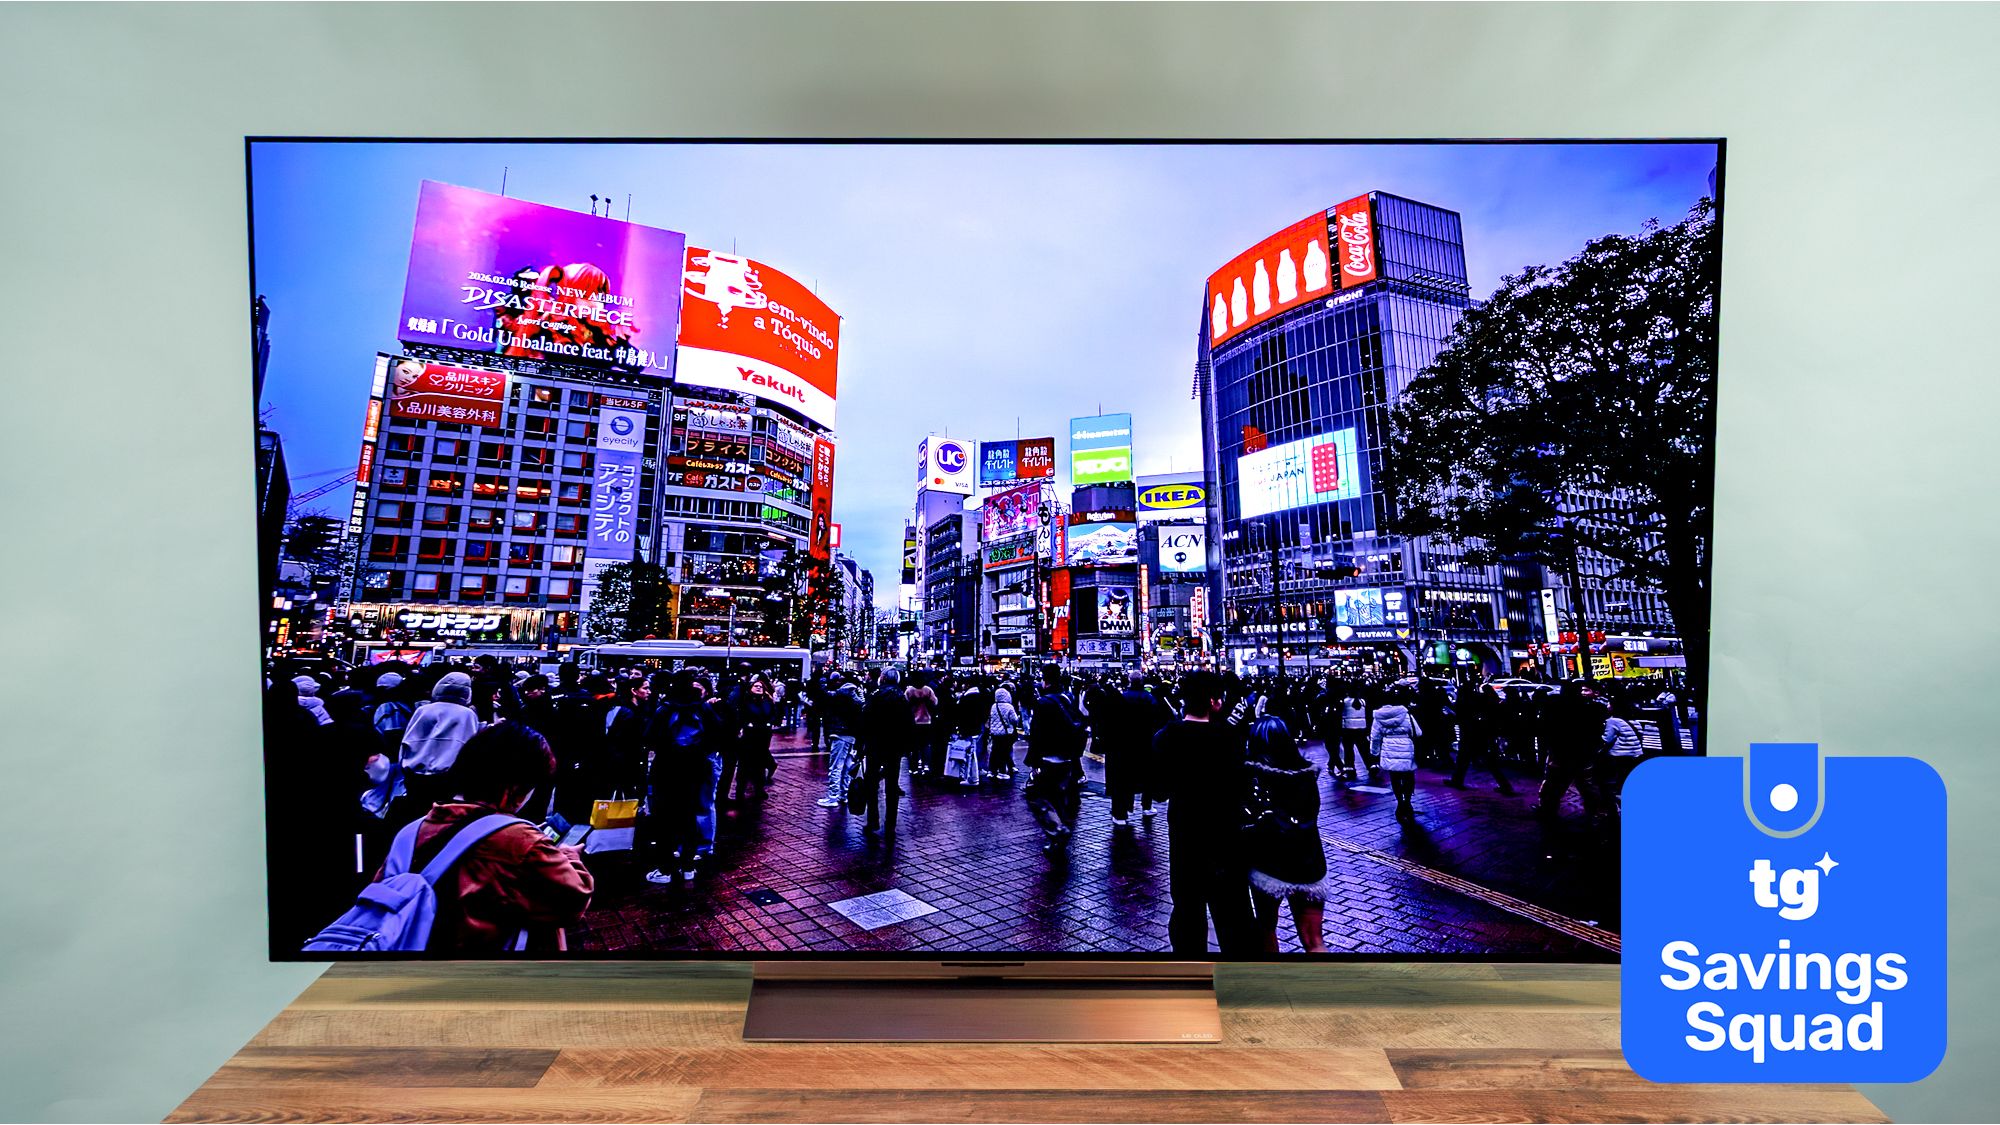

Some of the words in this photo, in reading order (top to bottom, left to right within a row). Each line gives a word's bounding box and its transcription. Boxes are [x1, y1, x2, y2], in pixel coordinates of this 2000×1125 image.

[467, 271, 519, 288] 2026.02.06
[556, 285, 587, 299] NEW
[588, 292, 634, 308] ALBUM
[460, 286, 634, 328] DISASTERPIECE
[497, 329, 580, 357] Unbalance
[581, 343, 614, 361] feat.
[753, 314, 766, 331] a
[770, 316, 821, 361] Tóquio
[444, 371, 501, 388] 品川スキン
[736, 366, 806, 404] Yakult
[443, 381, 496, 397] クリニック
[406, 401, 497, 423] 品川美容外科
[673, 413, 687, 422] 9F
[602, 436, 639, 448] eyecity
[938, 448, 964, 468] UC
[668, 472, 684, 482] 7F
[724, 462, 756, 475] ガスト
[1270, 466, 1305, 483] JAPAN
[704, 474, 742, 490] ガスト
[594, 463, 620, 542] アイシティ
[615, 465, 635, 543] コンタクトの
[1144, 489, 1201, 504] IKEA
[1161, 534, 1203, 548] ACN
[404, 613, 501, 630] サンドラッグ
[1100, 620, 1132, 631] DMM
